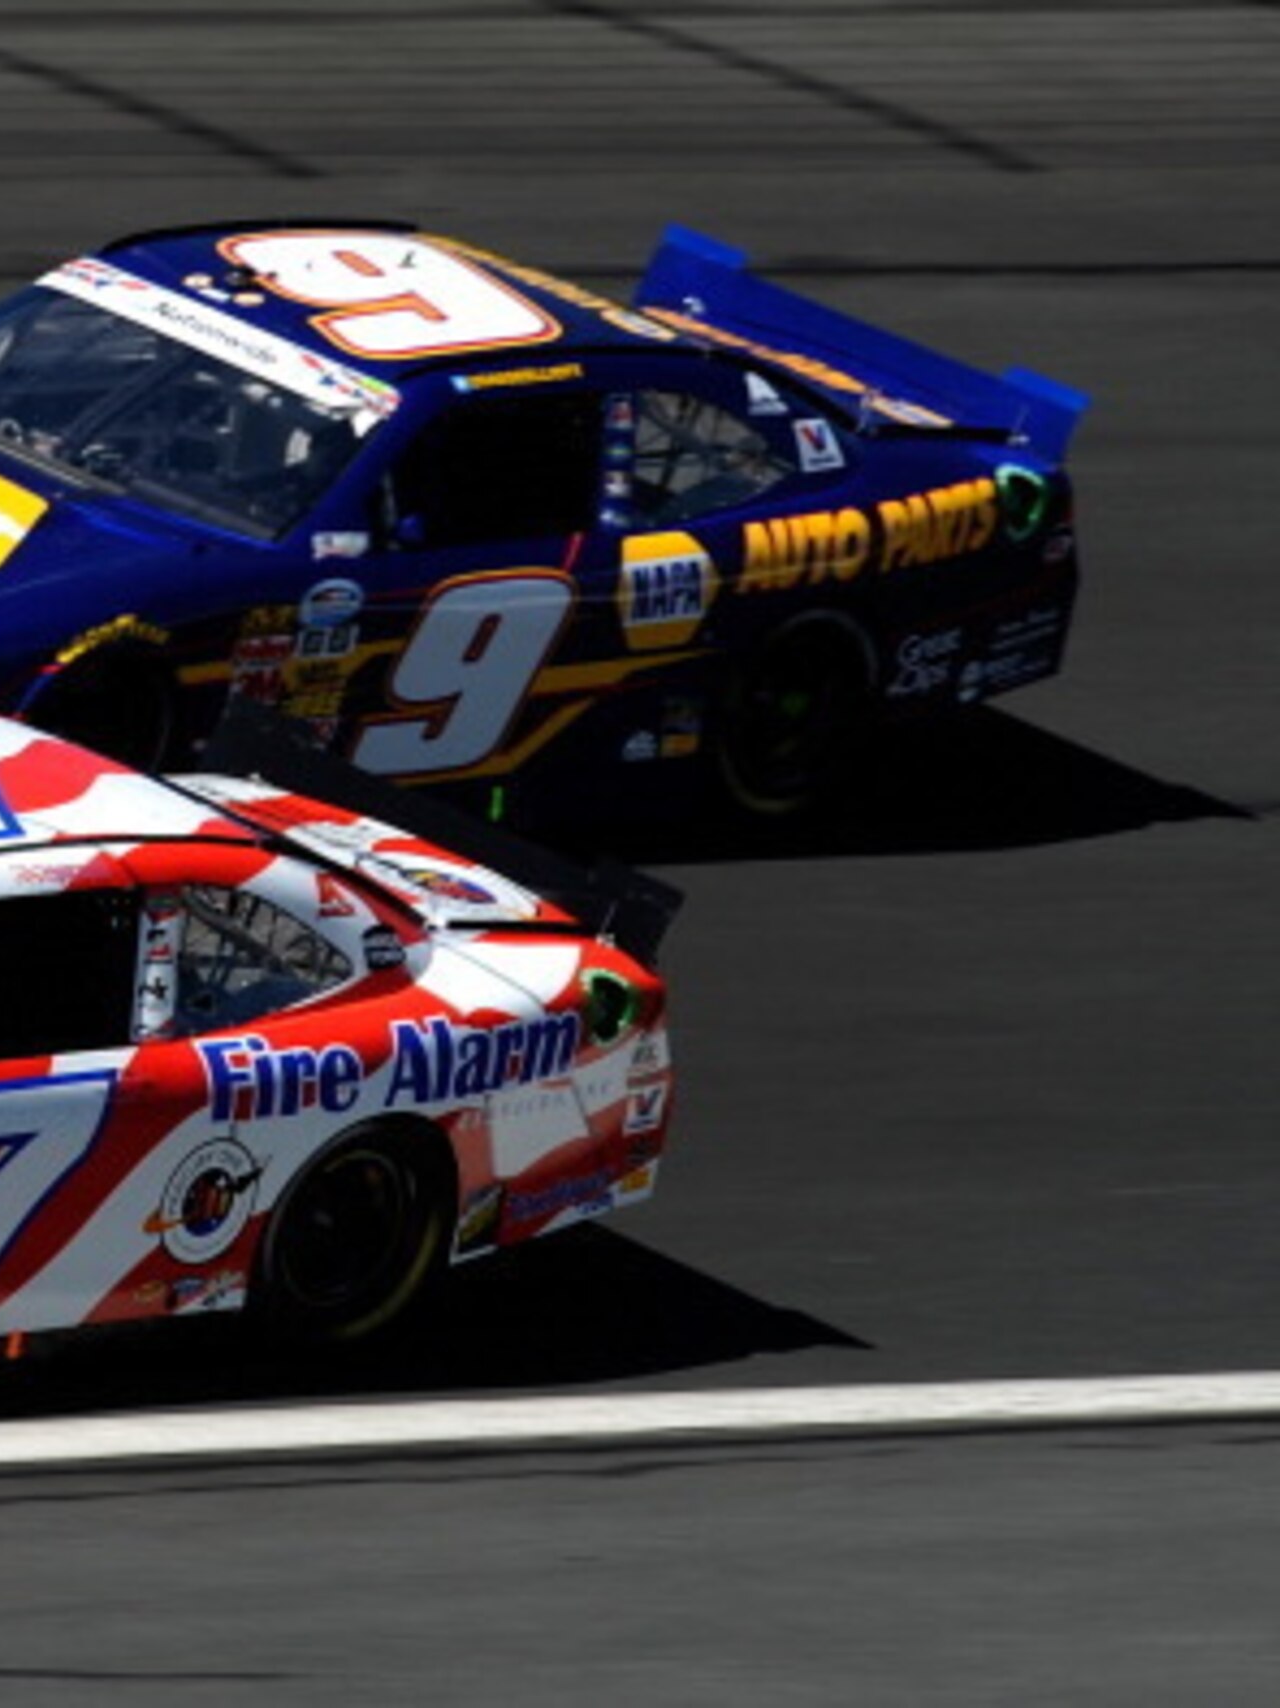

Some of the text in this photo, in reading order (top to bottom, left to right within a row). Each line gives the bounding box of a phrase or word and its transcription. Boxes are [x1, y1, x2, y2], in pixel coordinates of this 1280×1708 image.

[150, 301, 278, 366] Nationwide
[218, 230, 563, 360] 9
[628, 559, 703, 620] NAPA
[734, 478, 997, 593] AUTO PARTS
[350, 567, 577, 780] 9
[196, 1034, 365, 1122] Fire
[384, 1010, 581, 1107] Alarm
